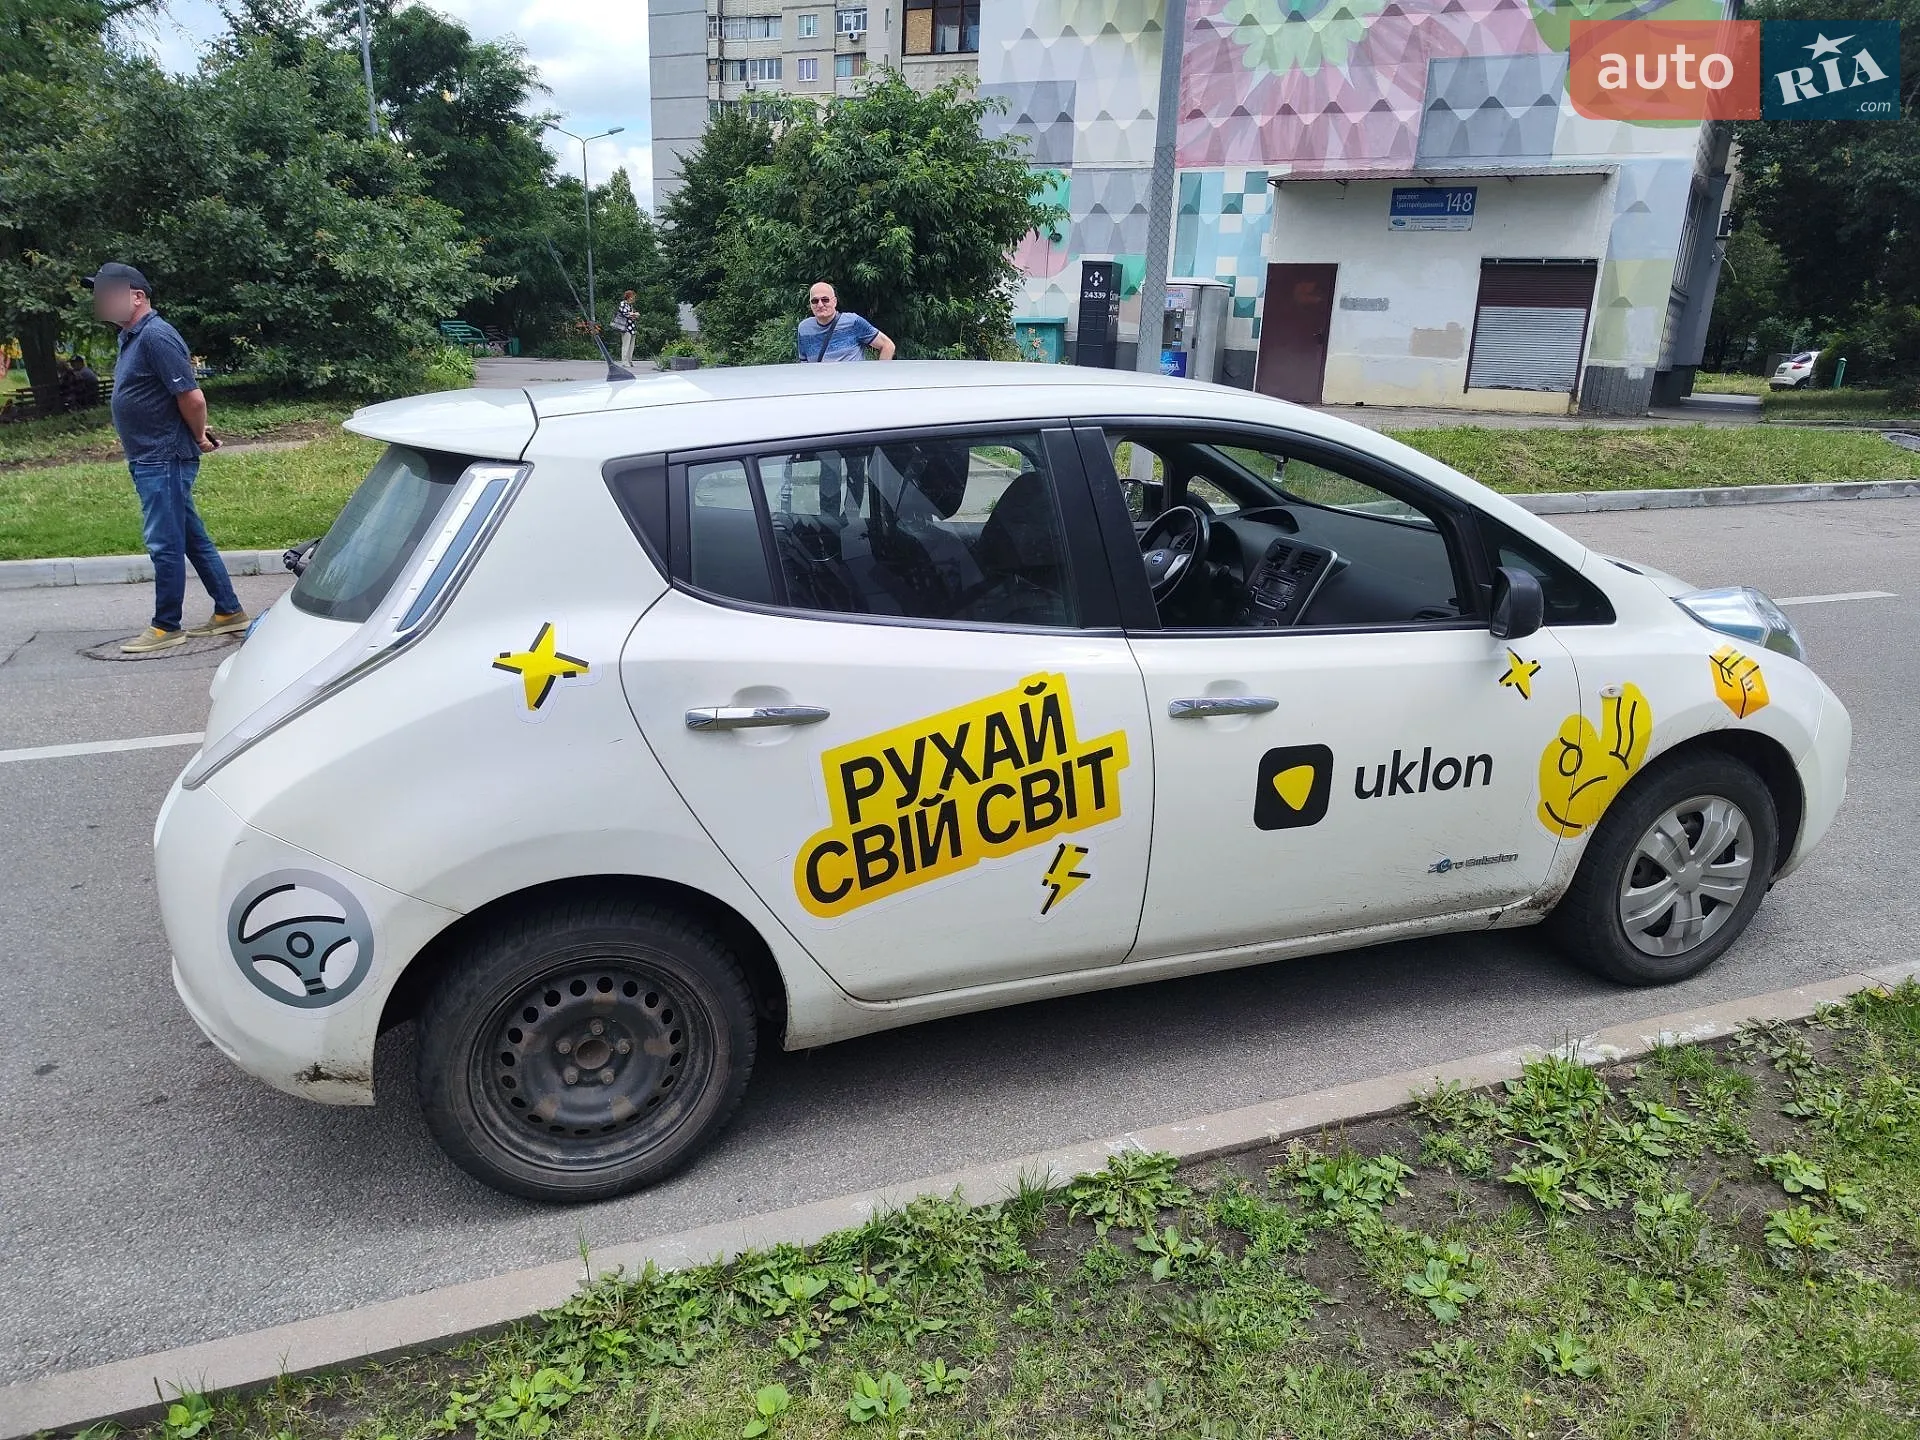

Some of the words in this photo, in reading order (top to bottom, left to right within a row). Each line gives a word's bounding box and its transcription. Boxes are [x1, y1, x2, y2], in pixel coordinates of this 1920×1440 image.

[1446, 192, 1473, 212] 148
[1083, 291, 1107, 300] 24339
[840, 681, 1068, 825] РУХАЙ
[1355, 747, 1493, 799] uklon
[806, 793, 963, 903] СВІЙ
[976, 746, 1114, 844] СВІТ
